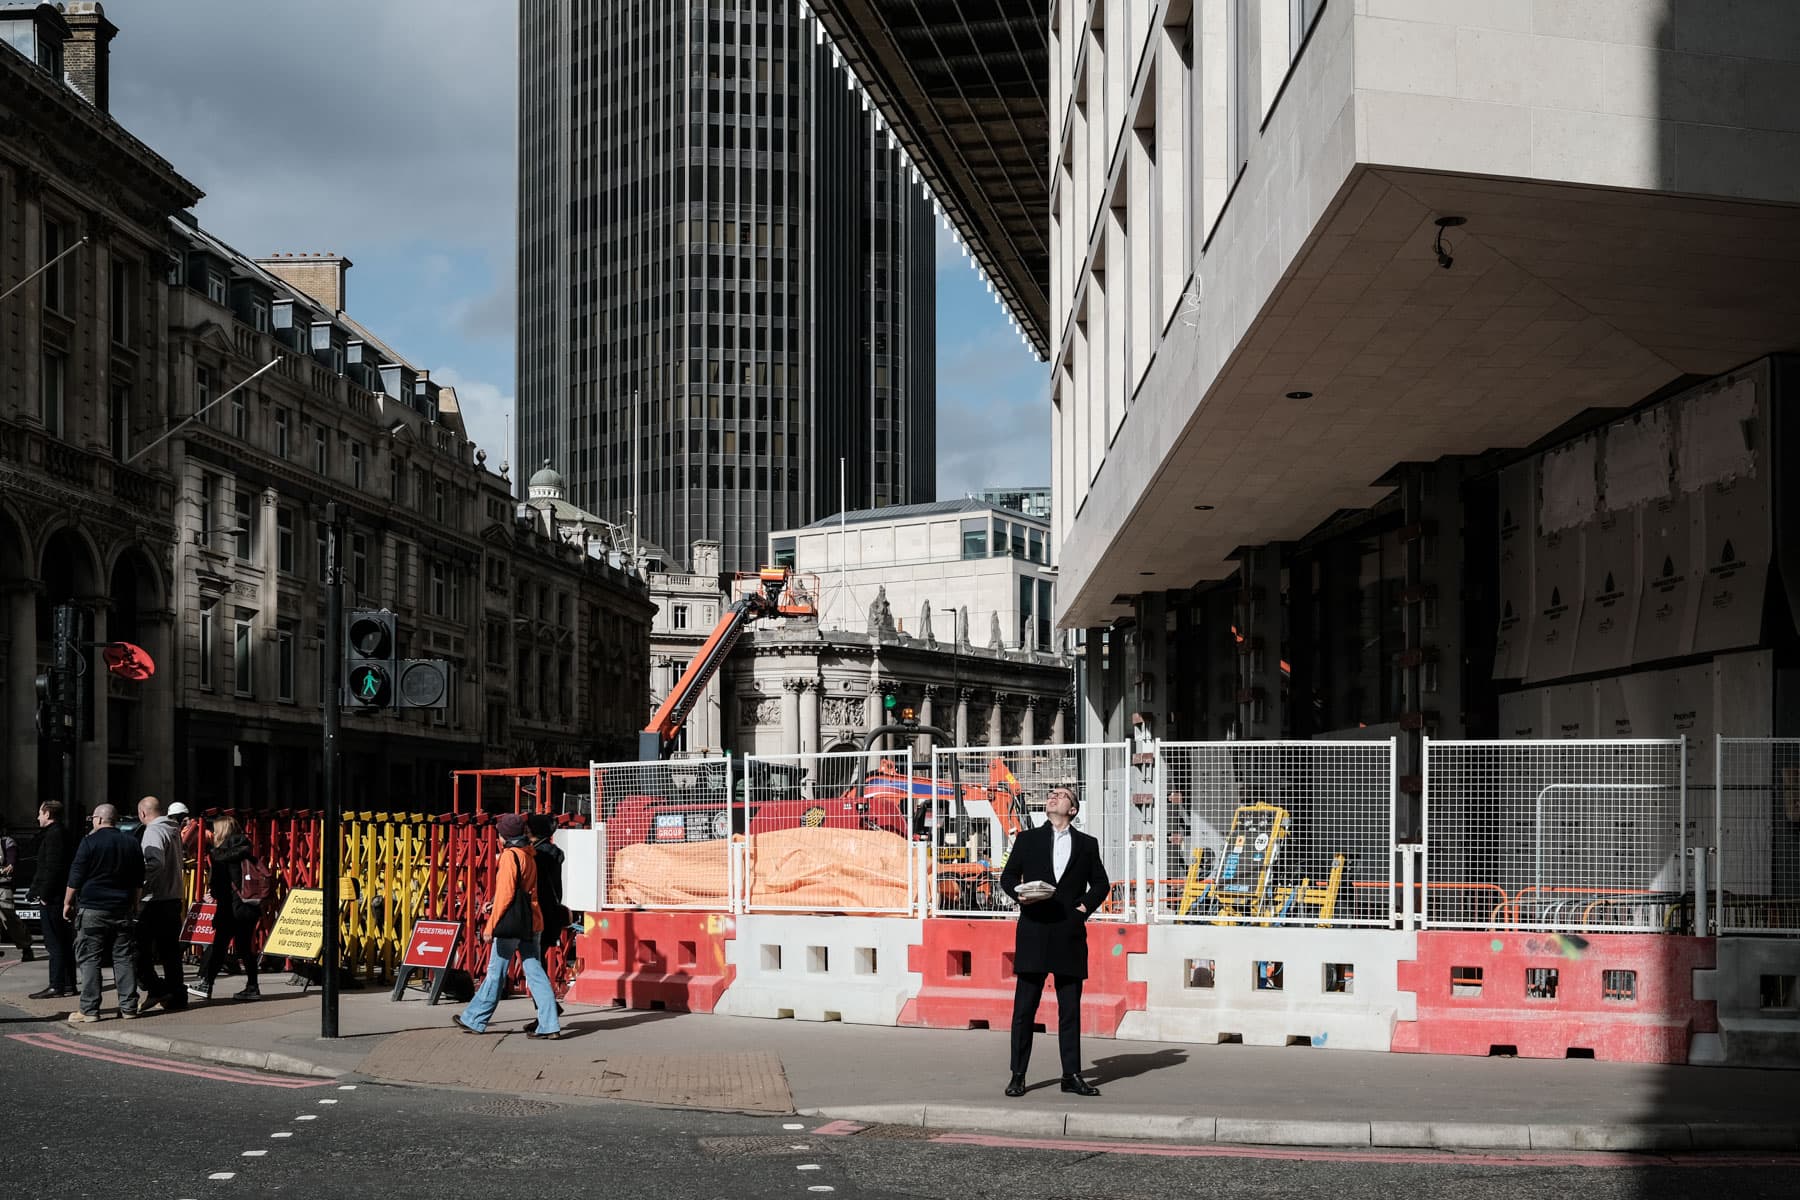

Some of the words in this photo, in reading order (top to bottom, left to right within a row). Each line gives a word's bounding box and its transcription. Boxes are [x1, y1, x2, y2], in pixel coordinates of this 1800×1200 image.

[659, 829, 683, 838] GROUP
[292, 895, 318, 905] Footpath
[290, 907, 310, 915] closed
[279, 915, 311, 926] Pedestrians
[278, 927, 295, 936] follow
[295, 929, 322, 938] diversion
[416, 927, 455, 936] PEDESTRIANS
[287, 939, 312, 951] crossing
